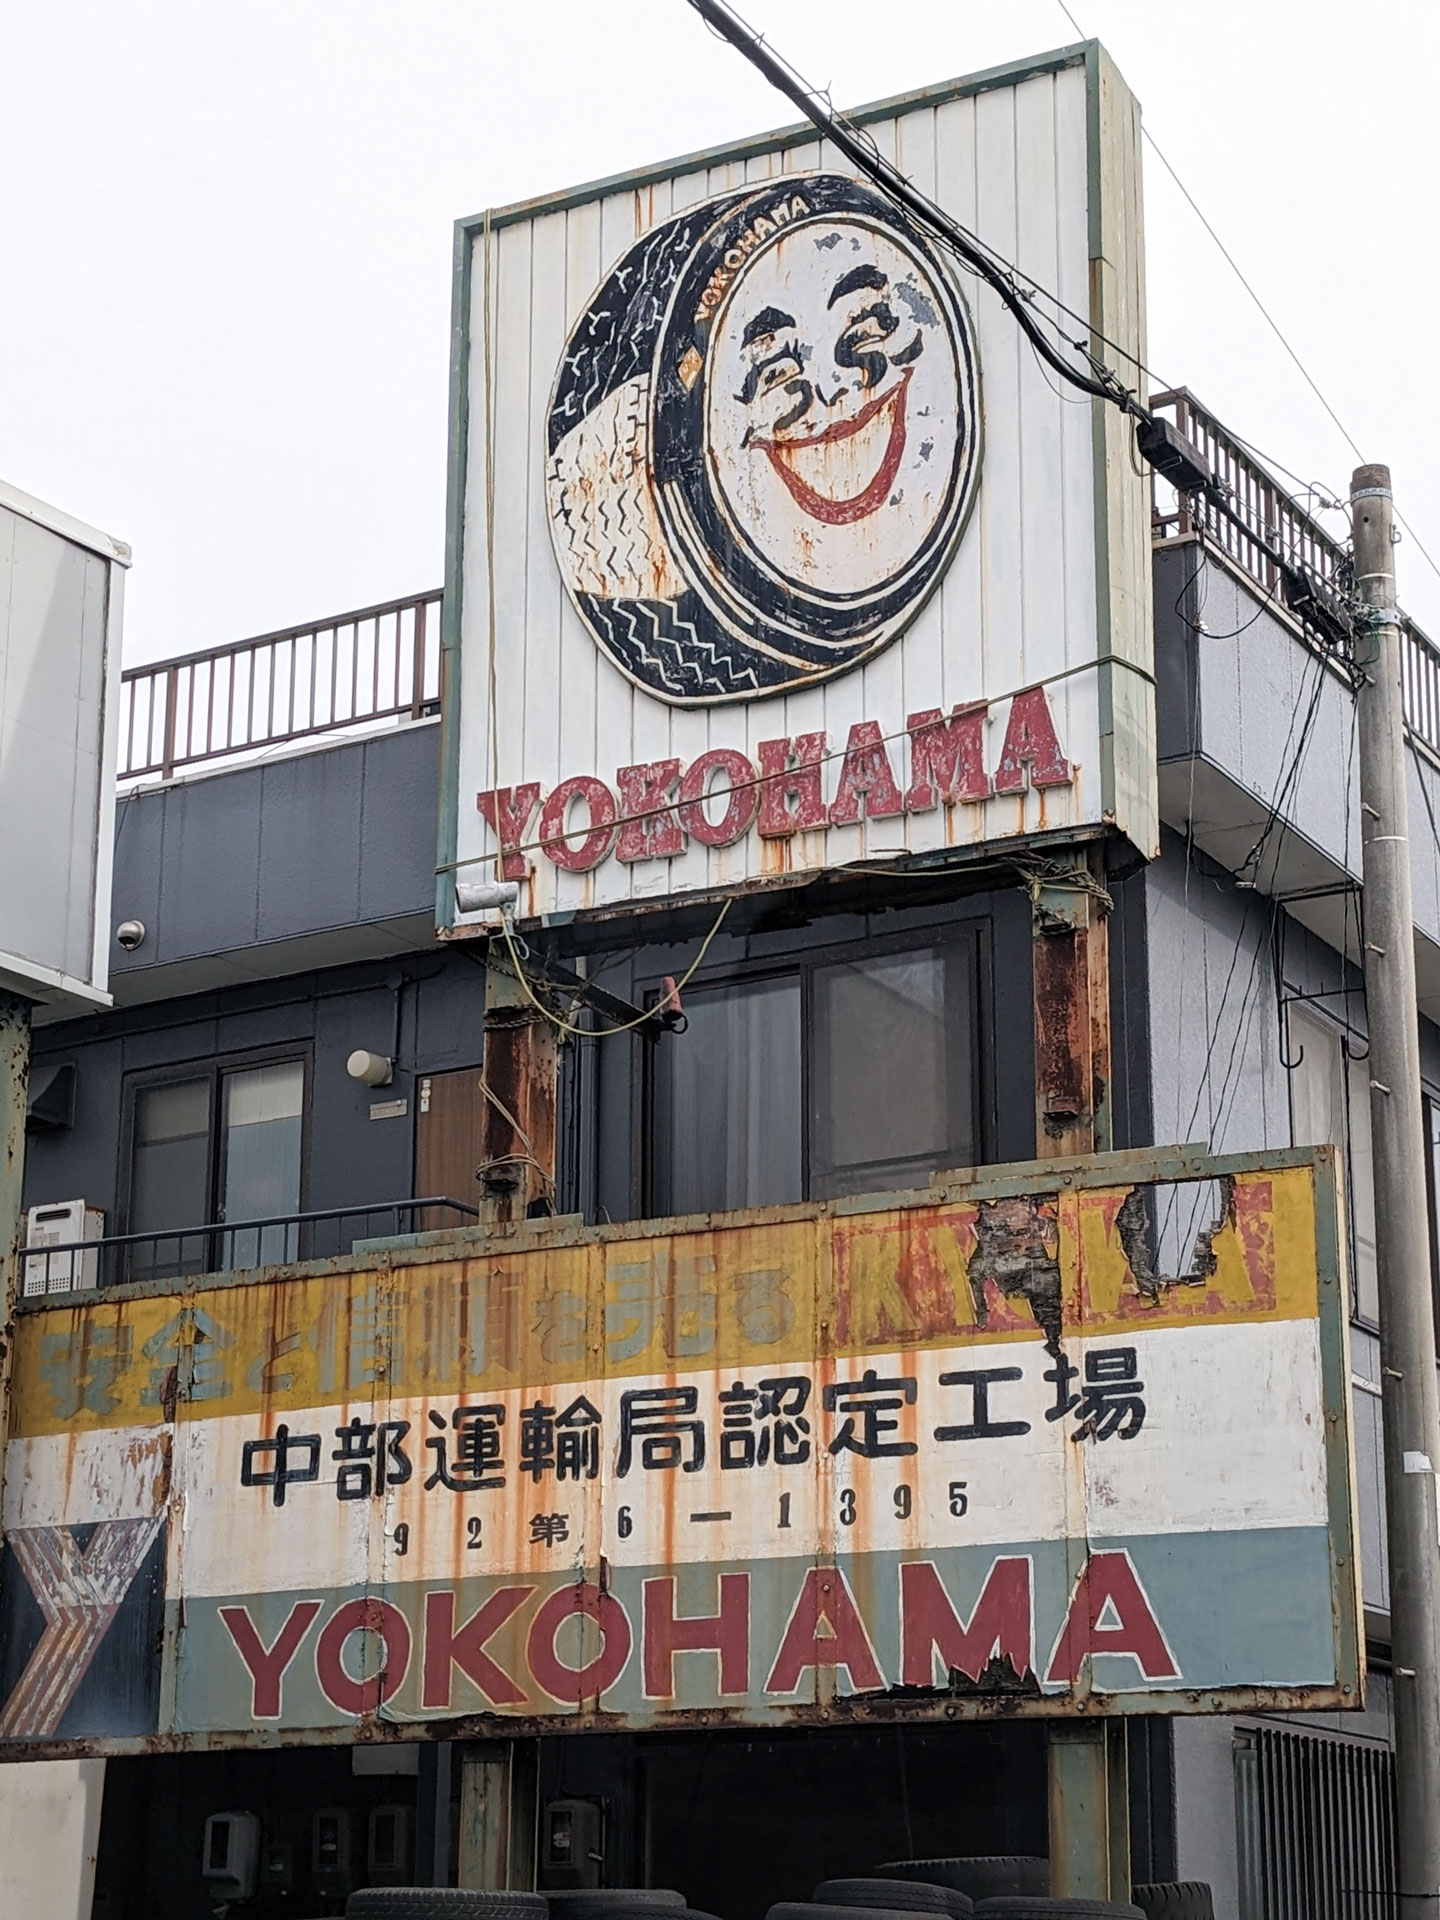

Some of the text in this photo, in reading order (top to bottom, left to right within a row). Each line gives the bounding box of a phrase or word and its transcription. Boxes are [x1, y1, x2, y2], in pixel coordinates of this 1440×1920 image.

[476, 686, 1074, 882] YOKOHAMA
[240, 1346, 1148, 1507] 中部運輸局認定工場
[217, 1548, 1184, 1720] YOKOHAMA
